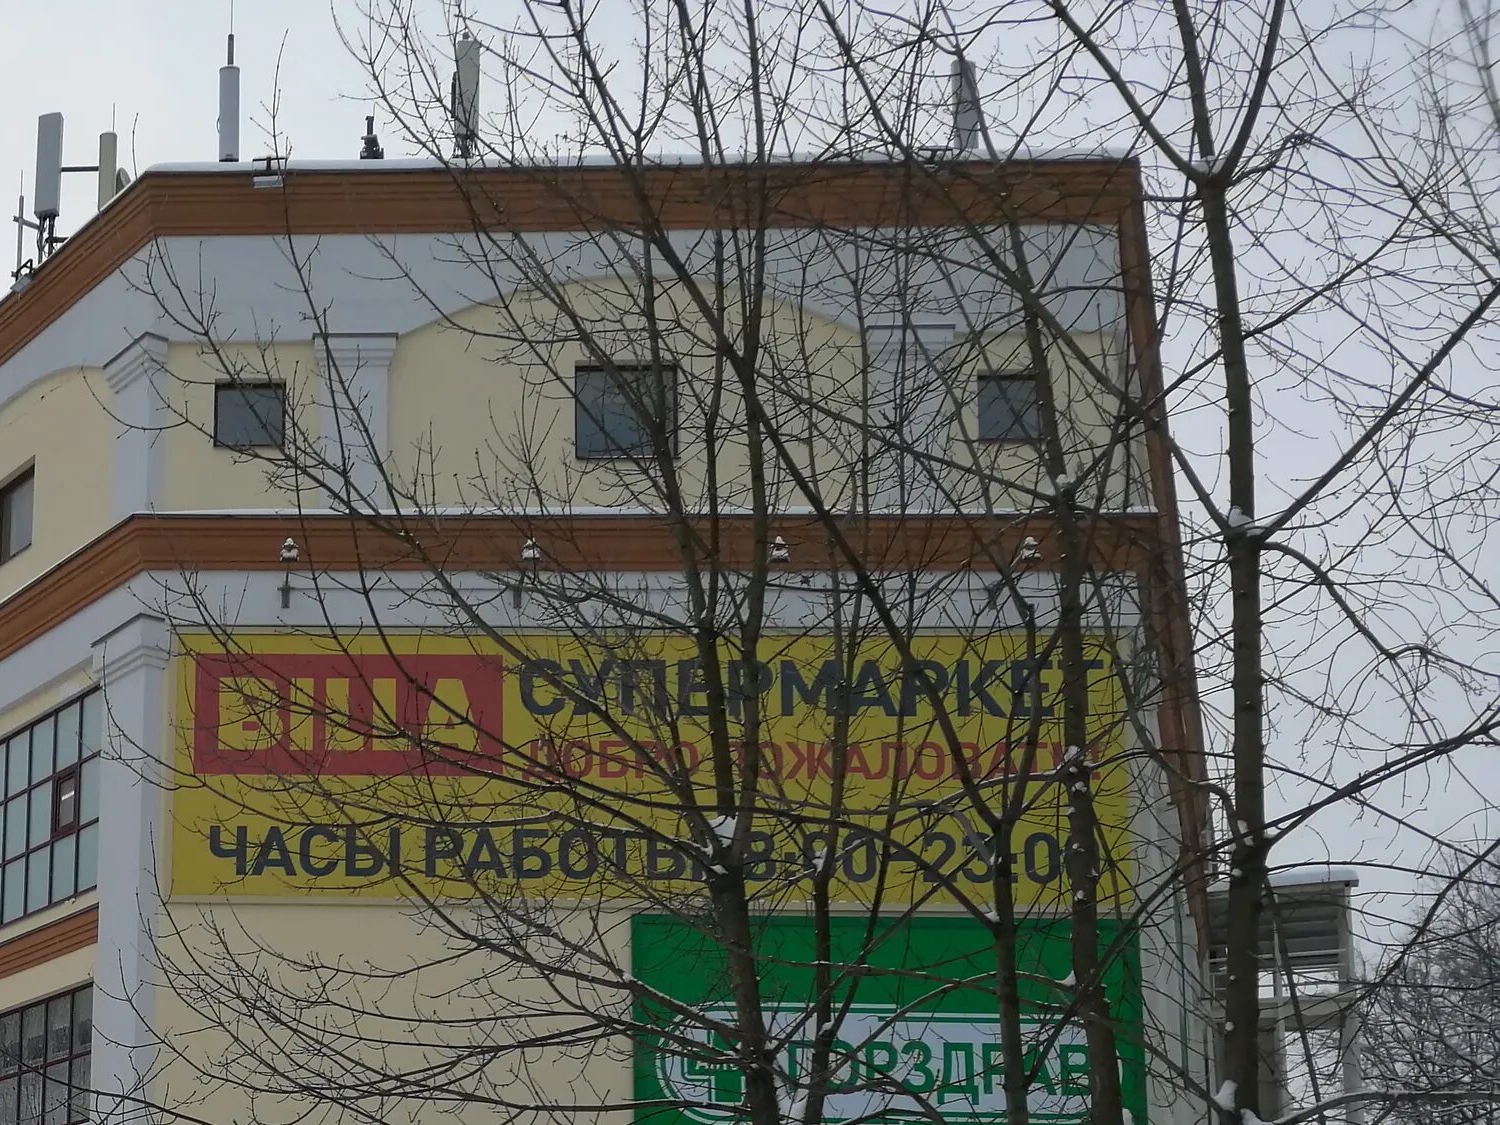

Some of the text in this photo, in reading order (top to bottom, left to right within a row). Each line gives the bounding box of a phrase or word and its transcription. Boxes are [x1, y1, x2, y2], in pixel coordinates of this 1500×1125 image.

[217, 677, 482, 752] BILLA
[209, 825, 400, 878] ЧАСЫ
[743, 831, 1101, 884] 8:00-23:0
[787, 1040, 1095, 1106] ГОРЗДРАВ
